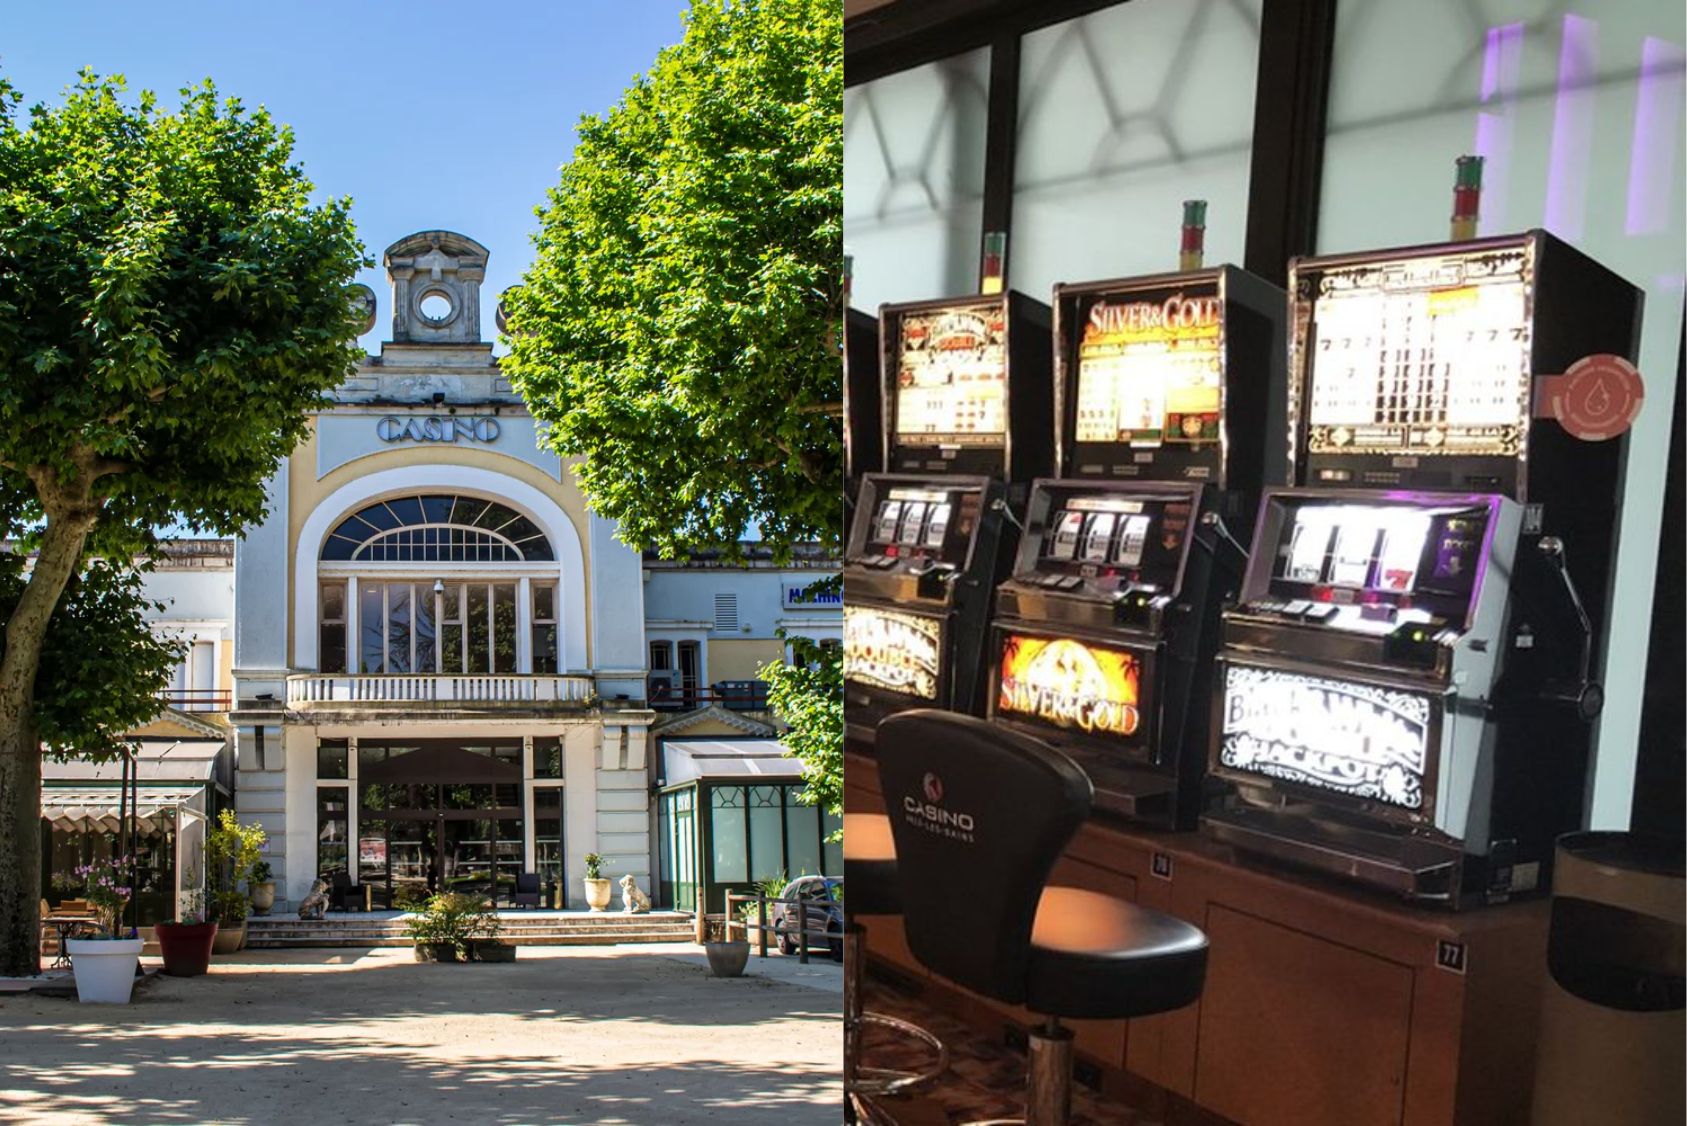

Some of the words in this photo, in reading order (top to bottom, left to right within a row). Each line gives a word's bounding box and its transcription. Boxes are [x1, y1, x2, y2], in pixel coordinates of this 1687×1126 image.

[376, 416, 500, 443] CASINO
[904, 796, 974, 831] CASINO
[1443, 944, 1459, 965] 77
